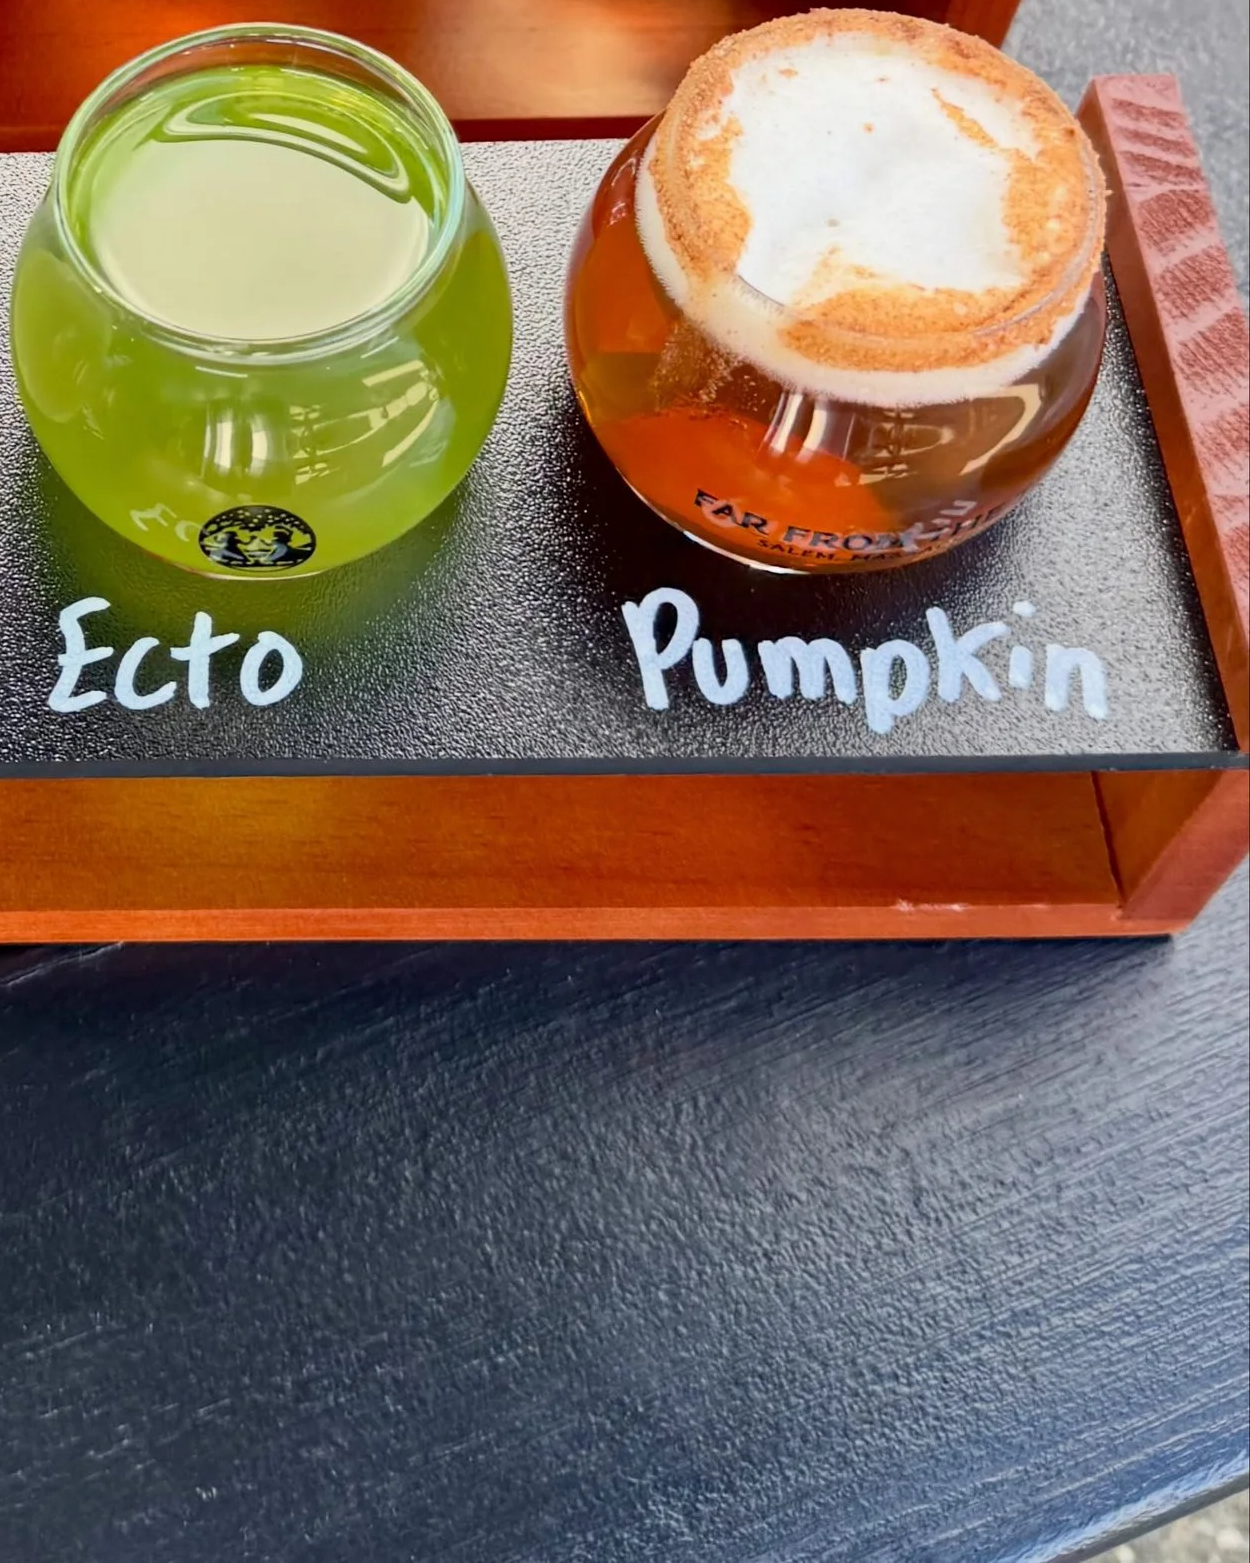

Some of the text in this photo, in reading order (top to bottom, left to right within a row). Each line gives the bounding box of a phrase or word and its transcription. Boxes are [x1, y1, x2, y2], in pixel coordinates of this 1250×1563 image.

[693, 488, 770, 536] FAR
[48, 595, 304, 713] Ecto
[621, 586, 1111, 735] Pumpkin
